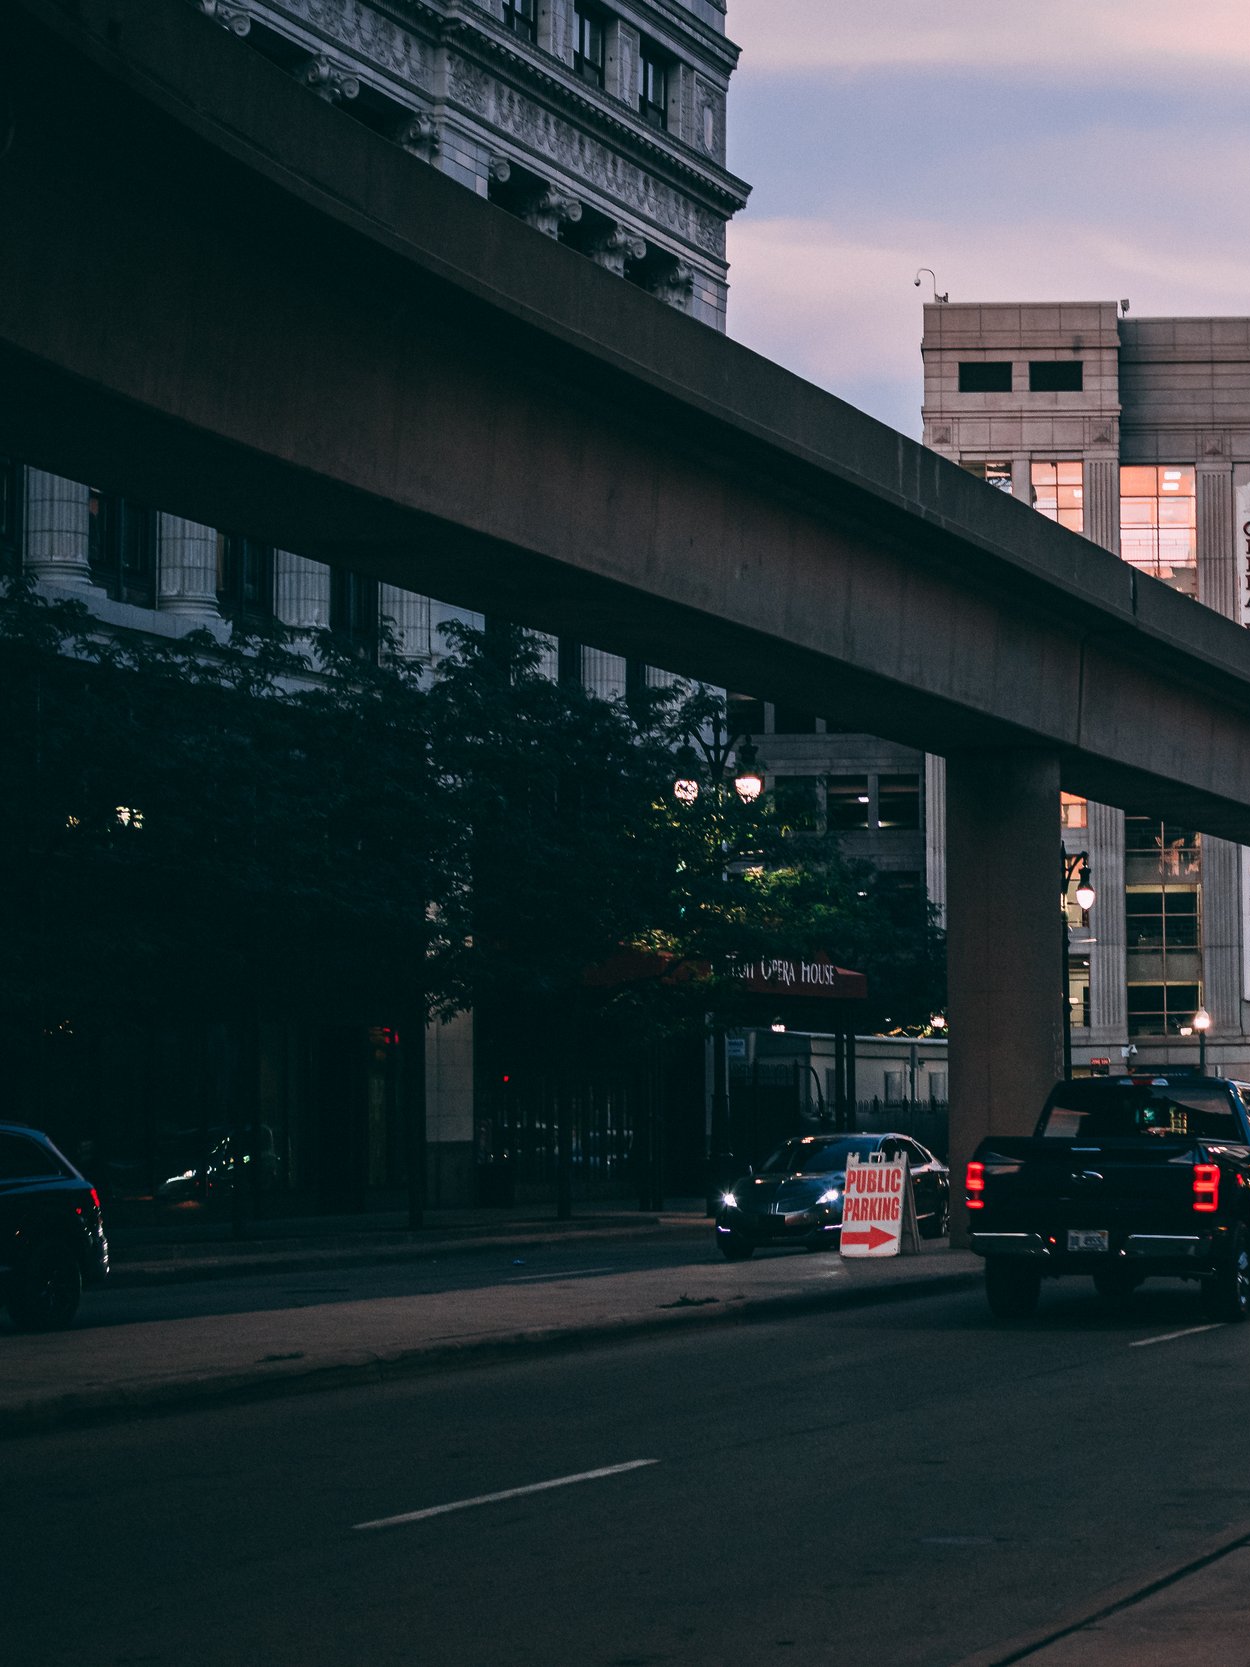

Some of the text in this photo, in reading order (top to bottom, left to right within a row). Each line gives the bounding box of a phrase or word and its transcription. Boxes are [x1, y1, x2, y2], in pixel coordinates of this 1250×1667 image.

[760, 955, 796, 986] OPERA
[801, 957, 835, 985] HOUSE
[846, 1169, 902, 1194] PUBLIC
[844, 1197, 900, 1221] PARKING
